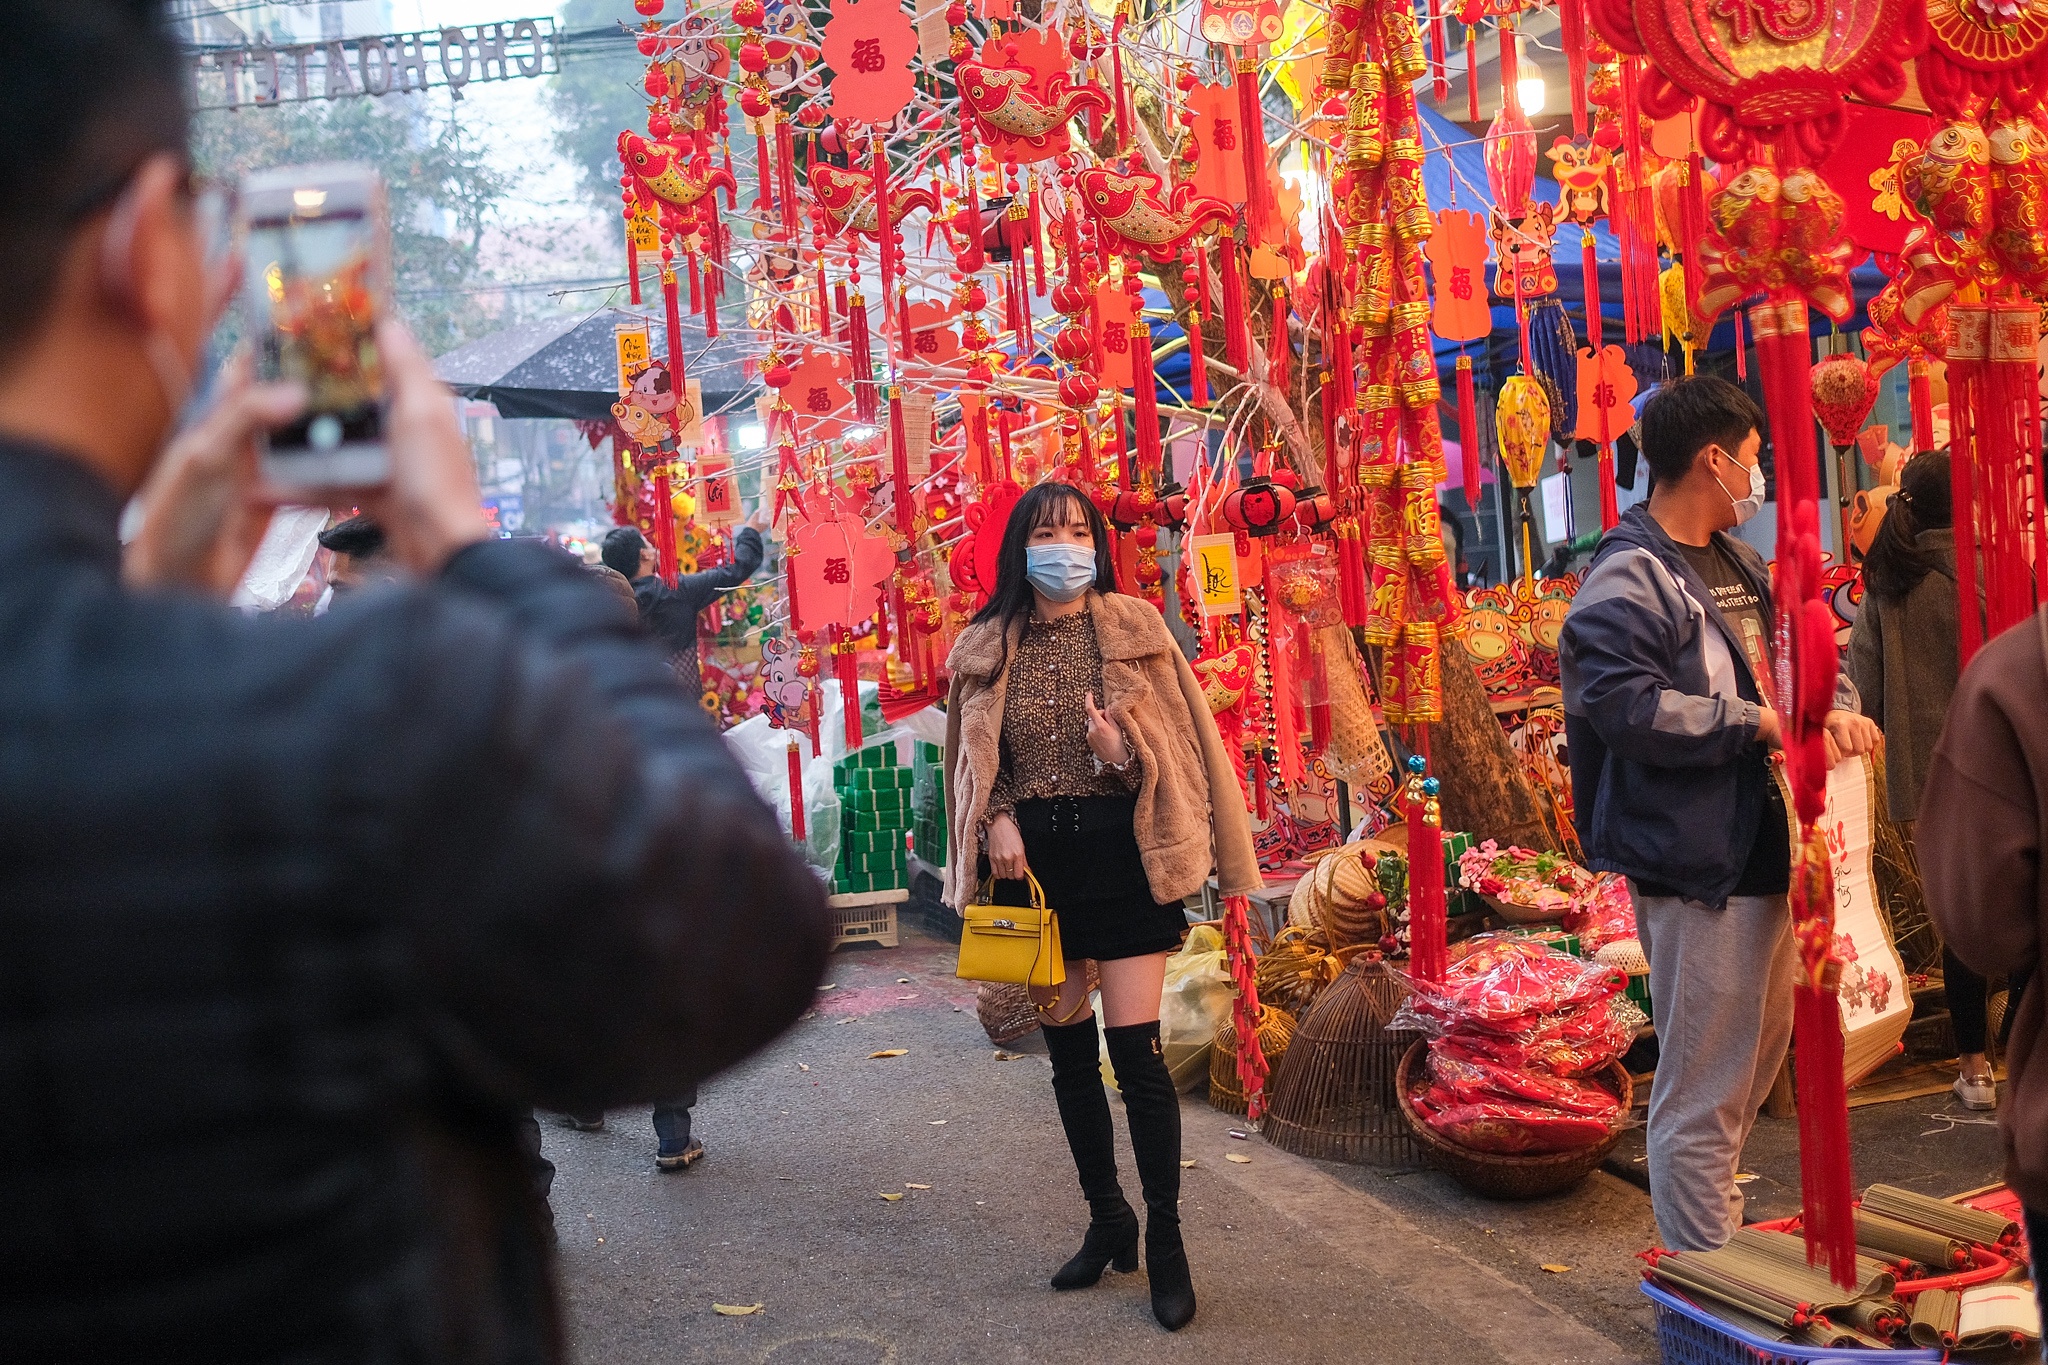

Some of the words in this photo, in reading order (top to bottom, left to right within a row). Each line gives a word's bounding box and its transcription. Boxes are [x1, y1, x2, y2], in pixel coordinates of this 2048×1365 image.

[851, 37, 885, 74] 福
[1213, 118, 1236, 151] 福
[1449, 265, 1472, 300] 福
[914, 329, 938, 354] 福
[1102, 319, 1128, 354] 福
[807, 387, 832, 412] 福
[1403, 487, 1440, 537] 福
[823, 557, 850, 585] 福
